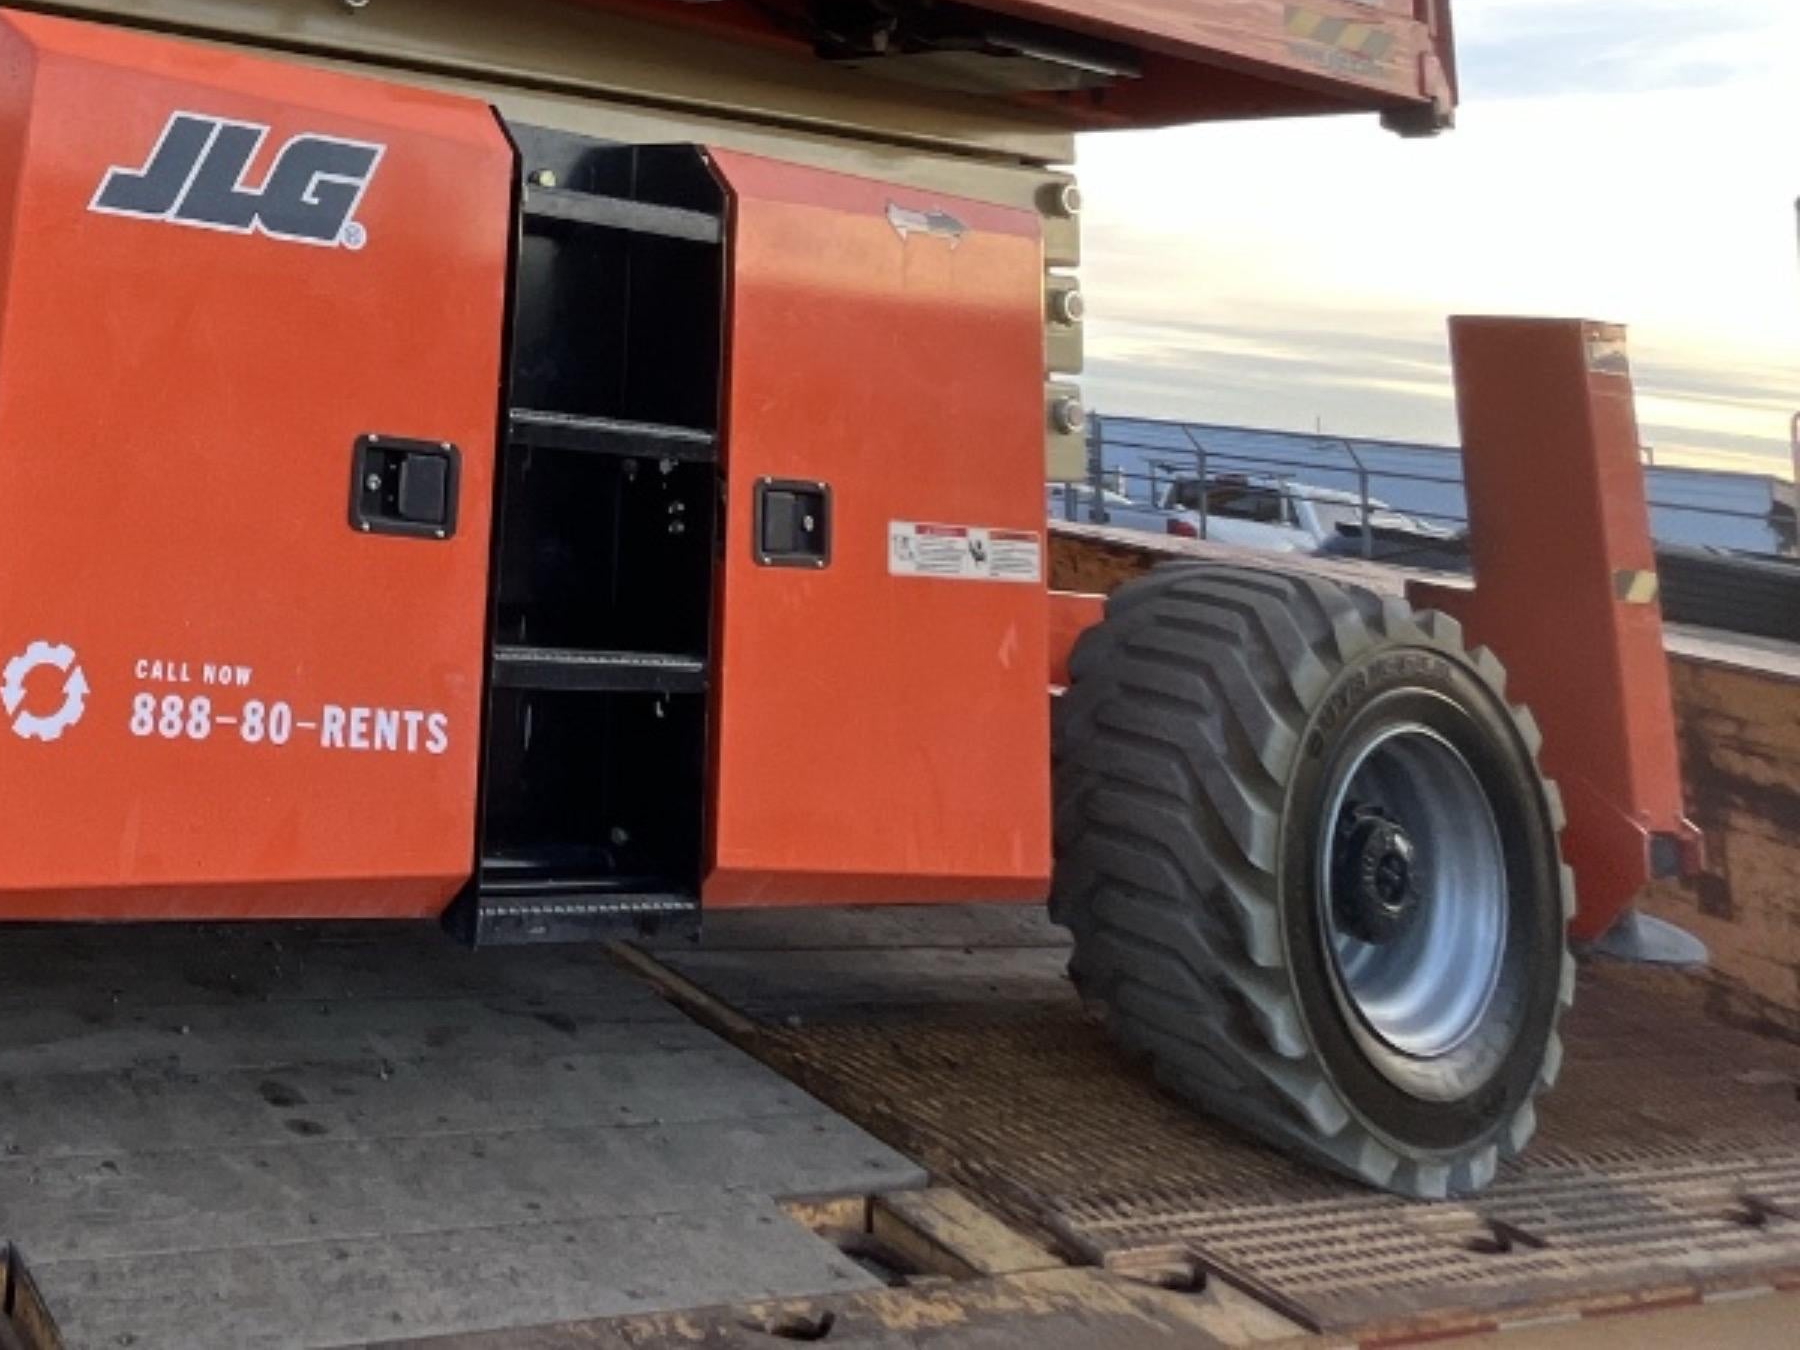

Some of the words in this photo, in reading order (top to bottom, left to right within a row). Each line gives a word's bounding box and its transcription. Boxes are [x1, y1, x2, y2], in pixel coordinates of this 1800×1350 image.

[134, 659, 192, 683] CALL
[203, 663, 253, 686] NOW
[130, 692, 449, 755] 888-80-RENTS
